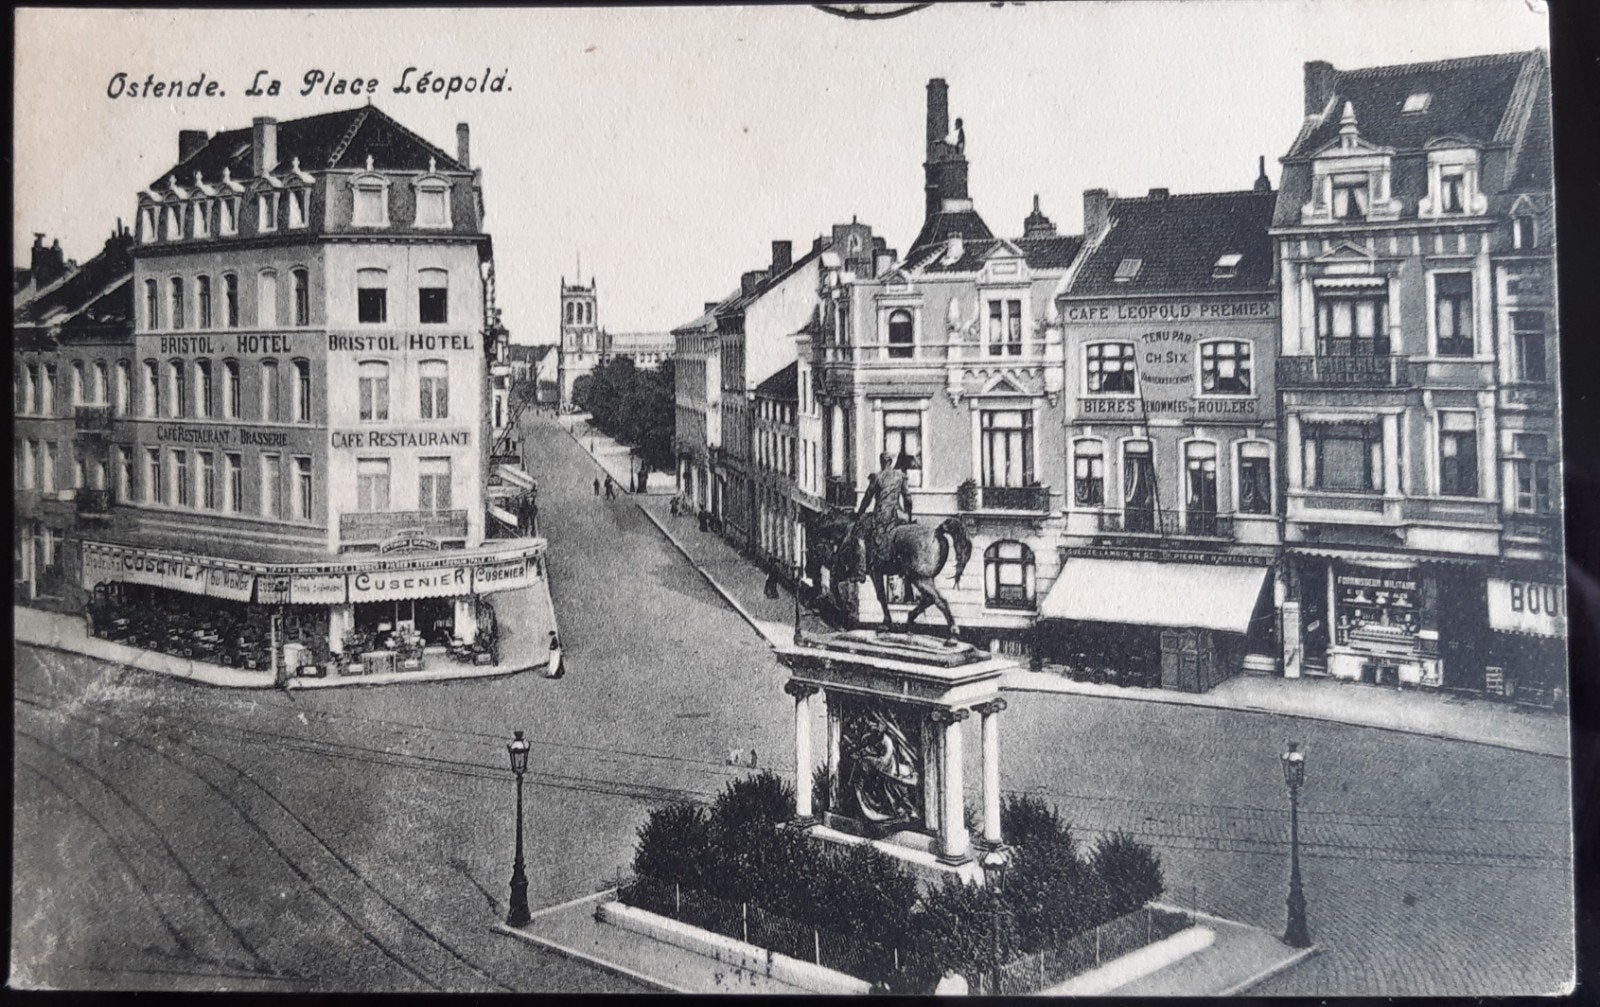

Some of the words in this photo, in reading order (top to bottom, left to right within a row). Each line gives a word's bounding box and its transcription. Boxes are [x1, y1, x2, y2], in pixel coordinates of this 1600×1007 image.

[161, 336, 214, 353] BRISTOL
[237, 335, 291, 353] HOTEL
[328, 334, 399, 351] BRISTOL
[409, 333, 474, 350] HOTEL
[1172, 331, 1192, 344] PAR
[240, 428, 287, 446] BRASSERIE
[369, 431, 471, 447] RESTAURANT
[355, 568, 465, 591] CUSENIER
[475, 566, 525, 583] CUSENIER
[1511, 582, 1566, 617] BOU
